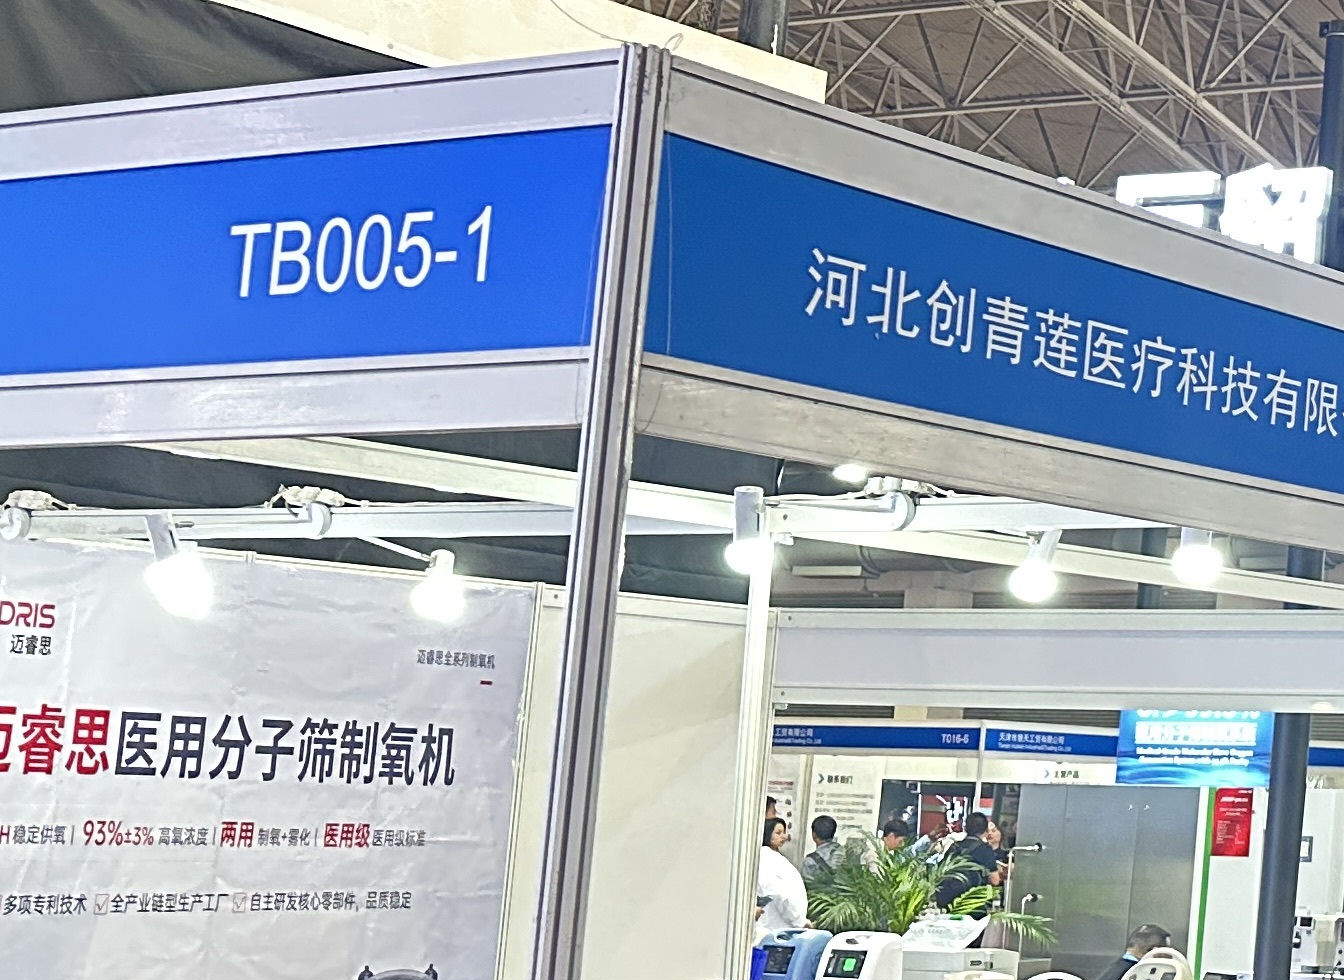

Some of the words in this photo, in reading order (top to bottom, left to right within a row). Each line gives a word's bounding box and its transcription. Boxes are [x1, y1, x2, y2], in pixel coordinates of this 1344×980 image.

[230, 205, 494, 298] TB005-1
[9, 634, 52, 656] 迈睿思
[13, 824, 67, 845] 稳定供氧
[158, 826, 209, 846] 高氧浓度
[220, 821, 255, 848] 两用
[323, 822, 371, 849] 医用级
[3, 893, 88, 916] 多项专利技术
